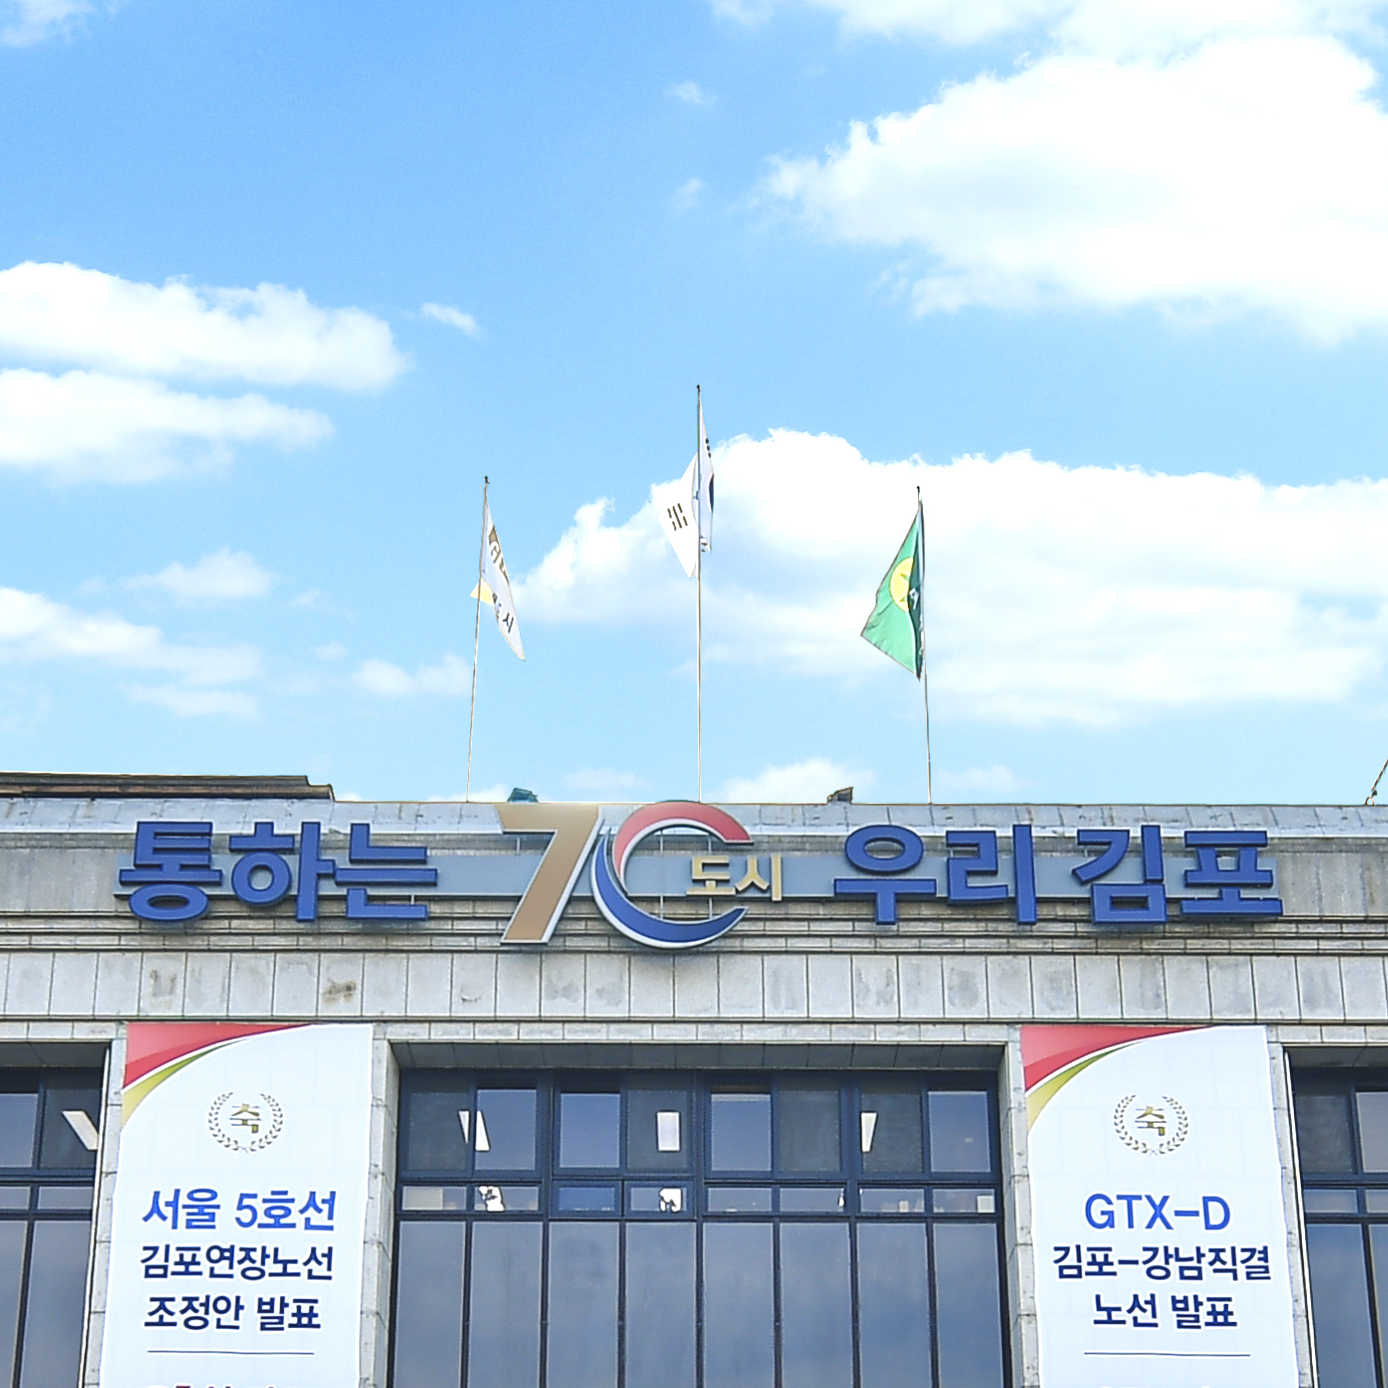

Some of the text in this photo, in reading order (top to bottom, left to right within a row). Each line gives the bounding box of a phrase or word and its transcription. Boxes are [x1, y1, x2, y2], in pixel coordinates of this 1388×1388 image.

[119, 821, 439, 921] 통하는
[685, 854, 783, 902] 도시
[229, 1103, 262, 1135] 축
[1134, 1105, 1167, 1137] 축
[142, 1187, 337, 1231] 서울 5호선
[1084, 1193, 1231, 1231] GTX-D
[140, 1244, 333, 1281] 김포연장노선
[1052, 1244, 1271, 1281] 김포-강남직결
[144, 1294, 321, 1332] 조정안 발표
[1093, 1293, 1238, 1329] 노선 발표
